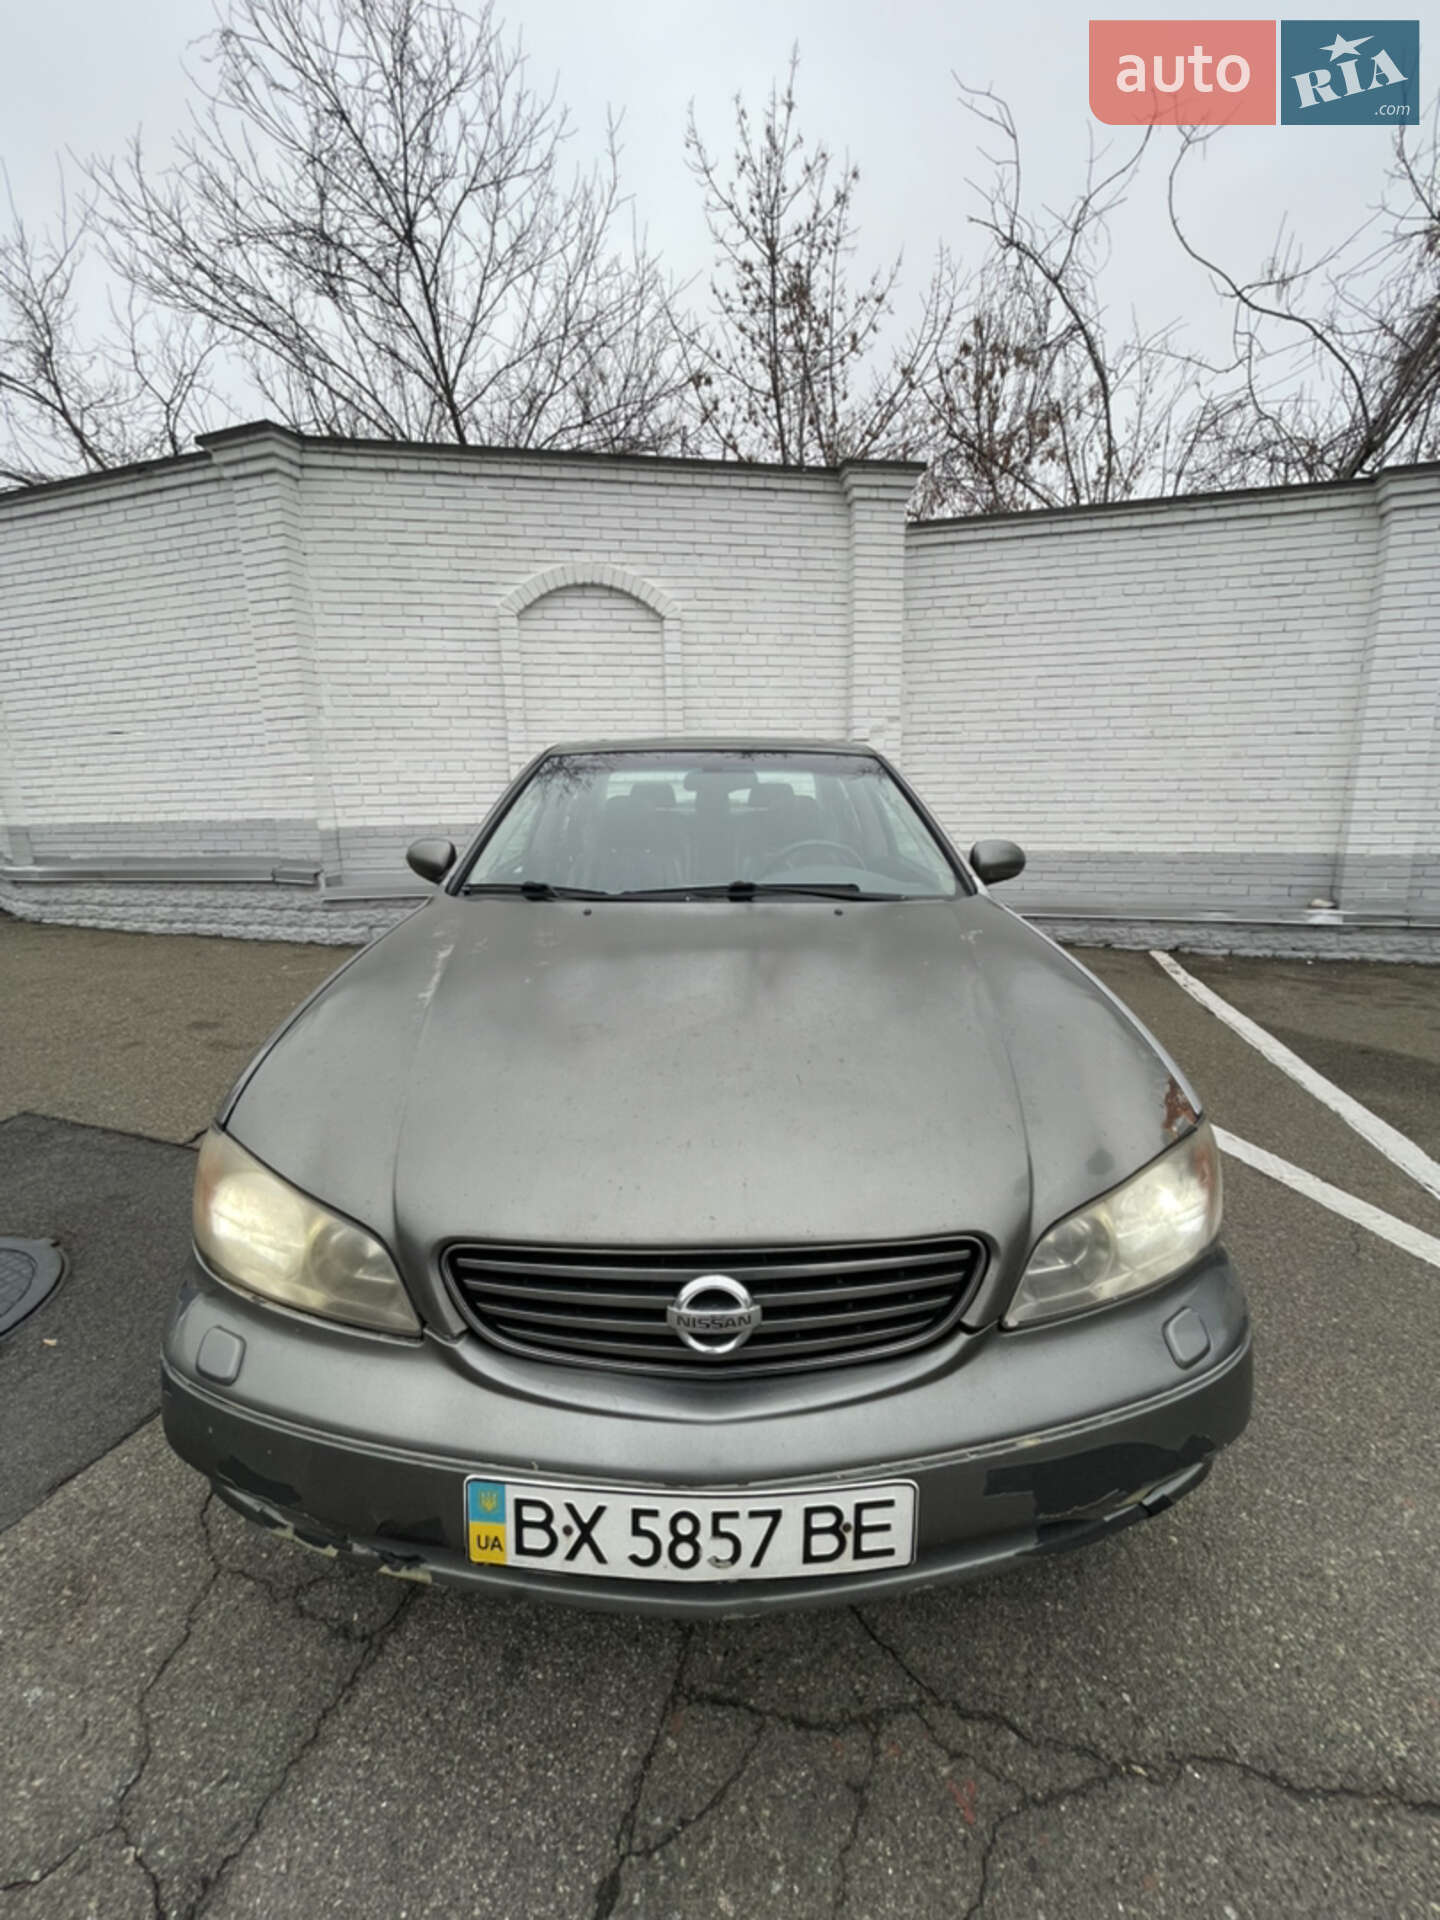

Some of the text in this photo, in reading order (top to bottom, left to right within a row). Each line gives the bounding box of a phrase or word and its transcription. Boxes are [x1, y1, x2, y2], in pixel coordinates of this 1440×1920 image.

[676, 1315, 752, 1329] NISSAN
[476, 1534, 504, 1552] UA
[628, 1507, 783, 1570] 5857
[802, 1499, 896, 1565] BE
